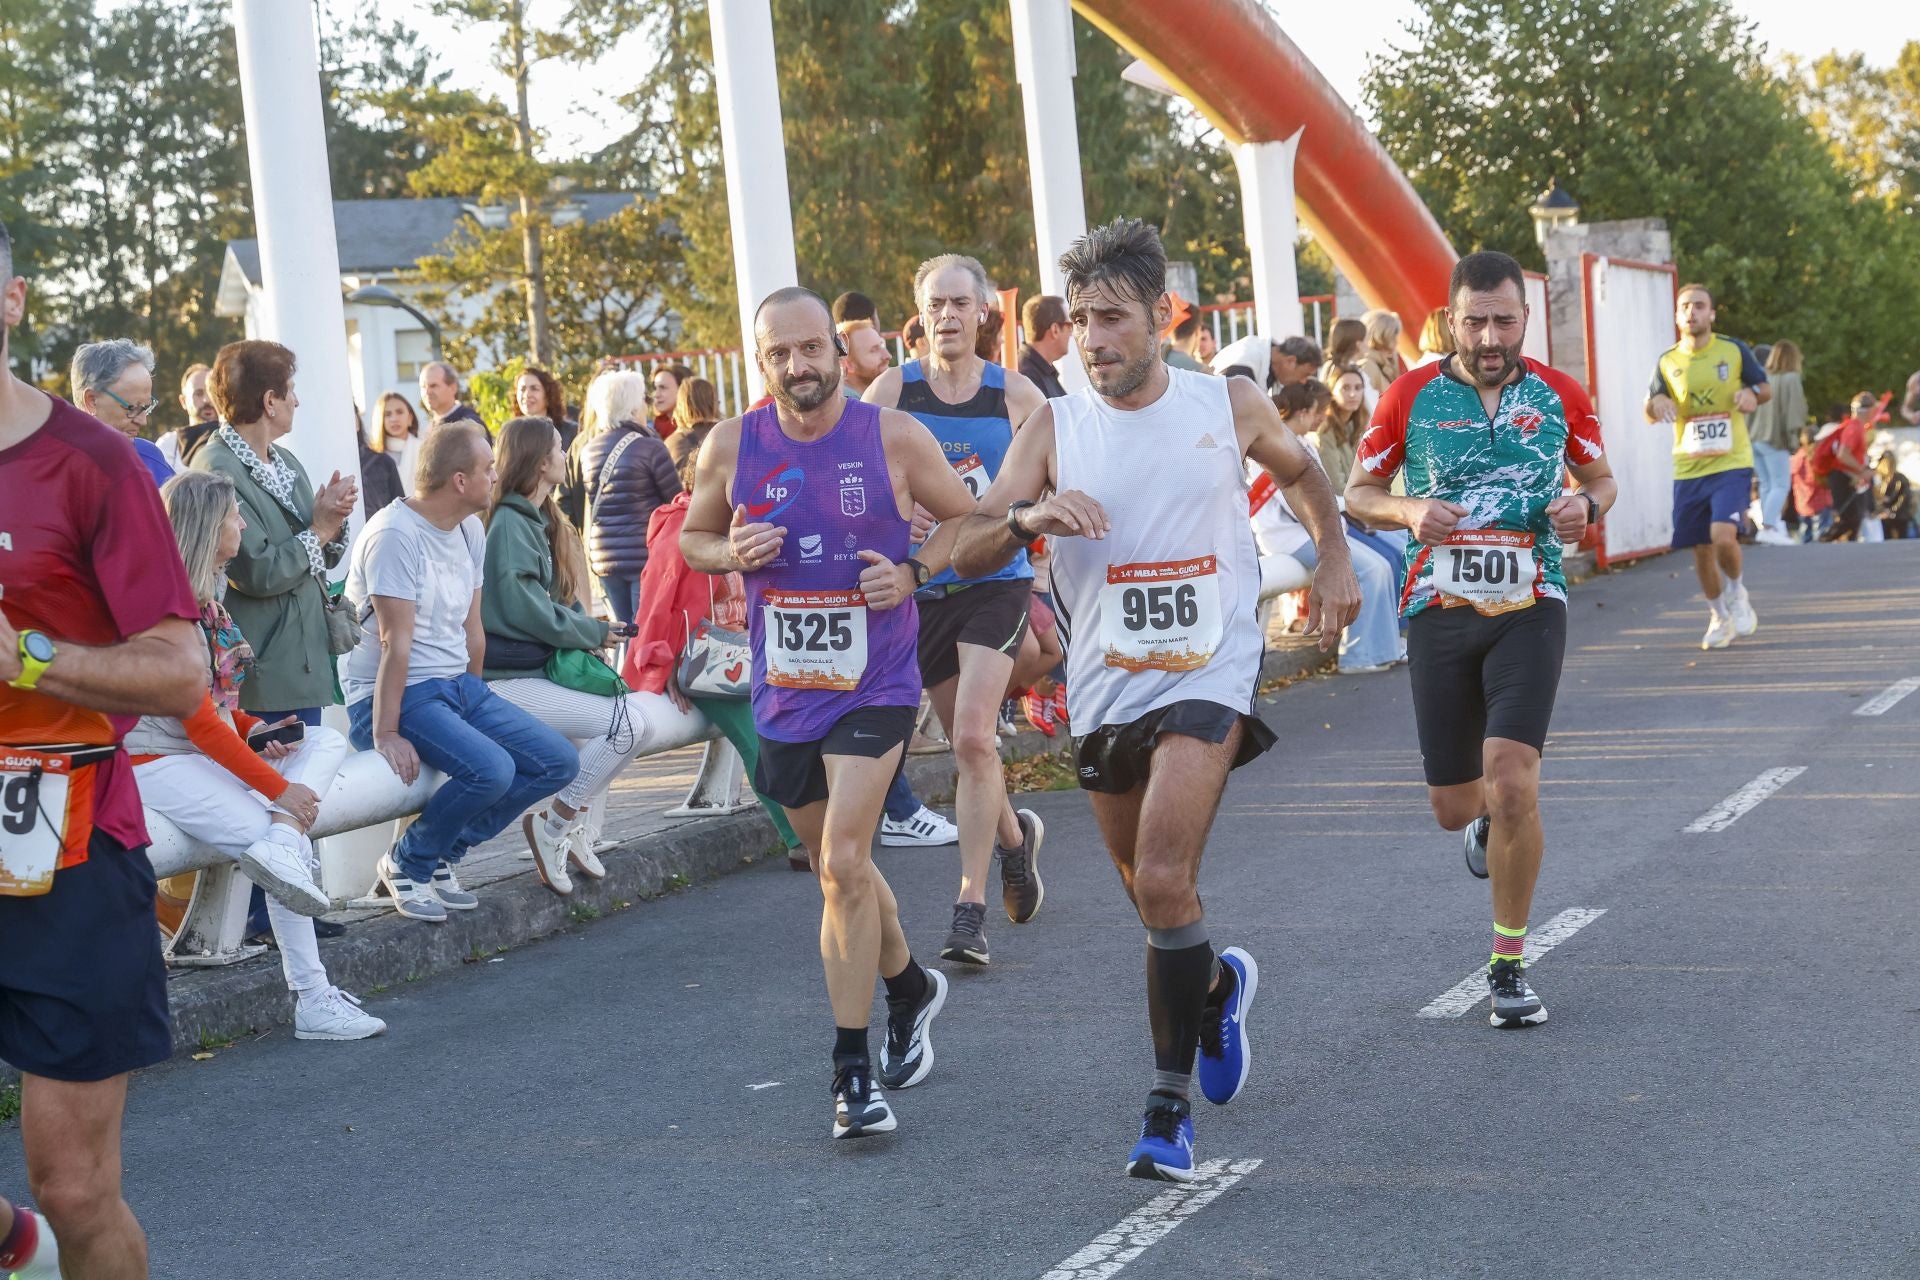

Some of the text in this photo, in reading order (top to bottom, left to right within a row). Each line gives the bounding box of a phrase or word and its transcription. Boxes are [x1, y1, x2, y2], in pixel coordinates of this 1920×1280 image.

[939, 440, 972, 454] OSE
[837, 461, 863, 470] VESKIN
[765, 483, 788, 502] kp
[1134, 569, 1158, 577] MBA
[1178, 563, 1200, 575] GIJÓN
[1449, 548, 1519, 585] 1501
[783, 596, 806, 604] MBA
[824, 594, 848, 604] GIJÓN
[1122, 583, 1199, 632] 956
[773, 610, 852, 651] 1325
[5, 756, 42, 767] GIJÓN
[0, 775, 39, 835] 9
